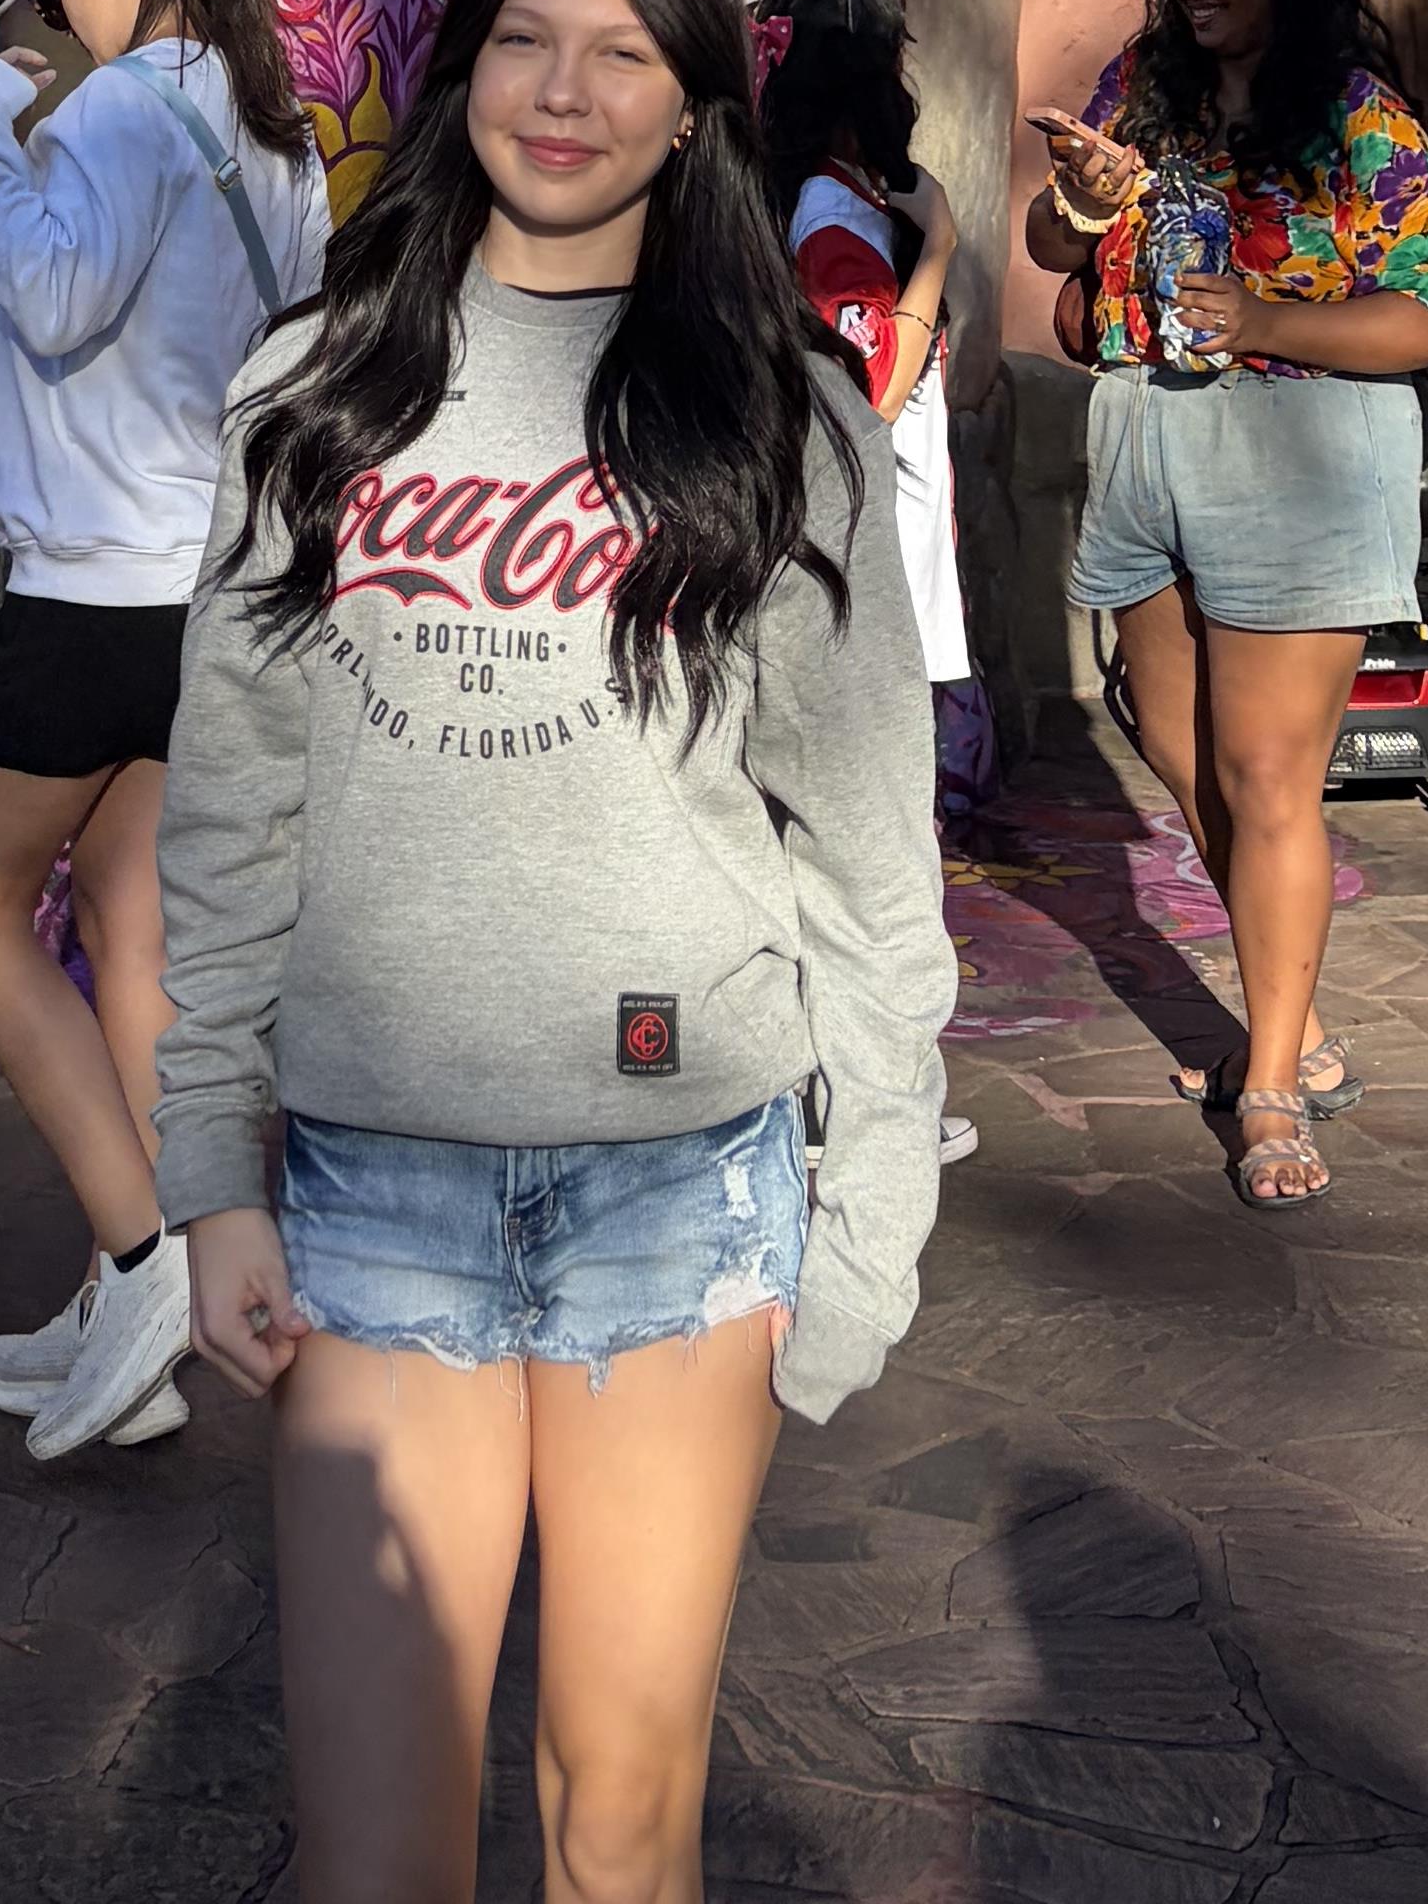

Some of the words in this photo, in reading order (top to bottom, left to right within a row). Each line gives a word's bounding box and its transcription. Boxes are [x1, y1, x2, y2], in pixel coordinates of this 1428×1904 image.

[332, 454, 652, 614] oca-Co
[415, 622, 551, 662] BOTTLING
[460, 662, 504, 696] CO.
[438, 713, 574, 761] FLORIDA
